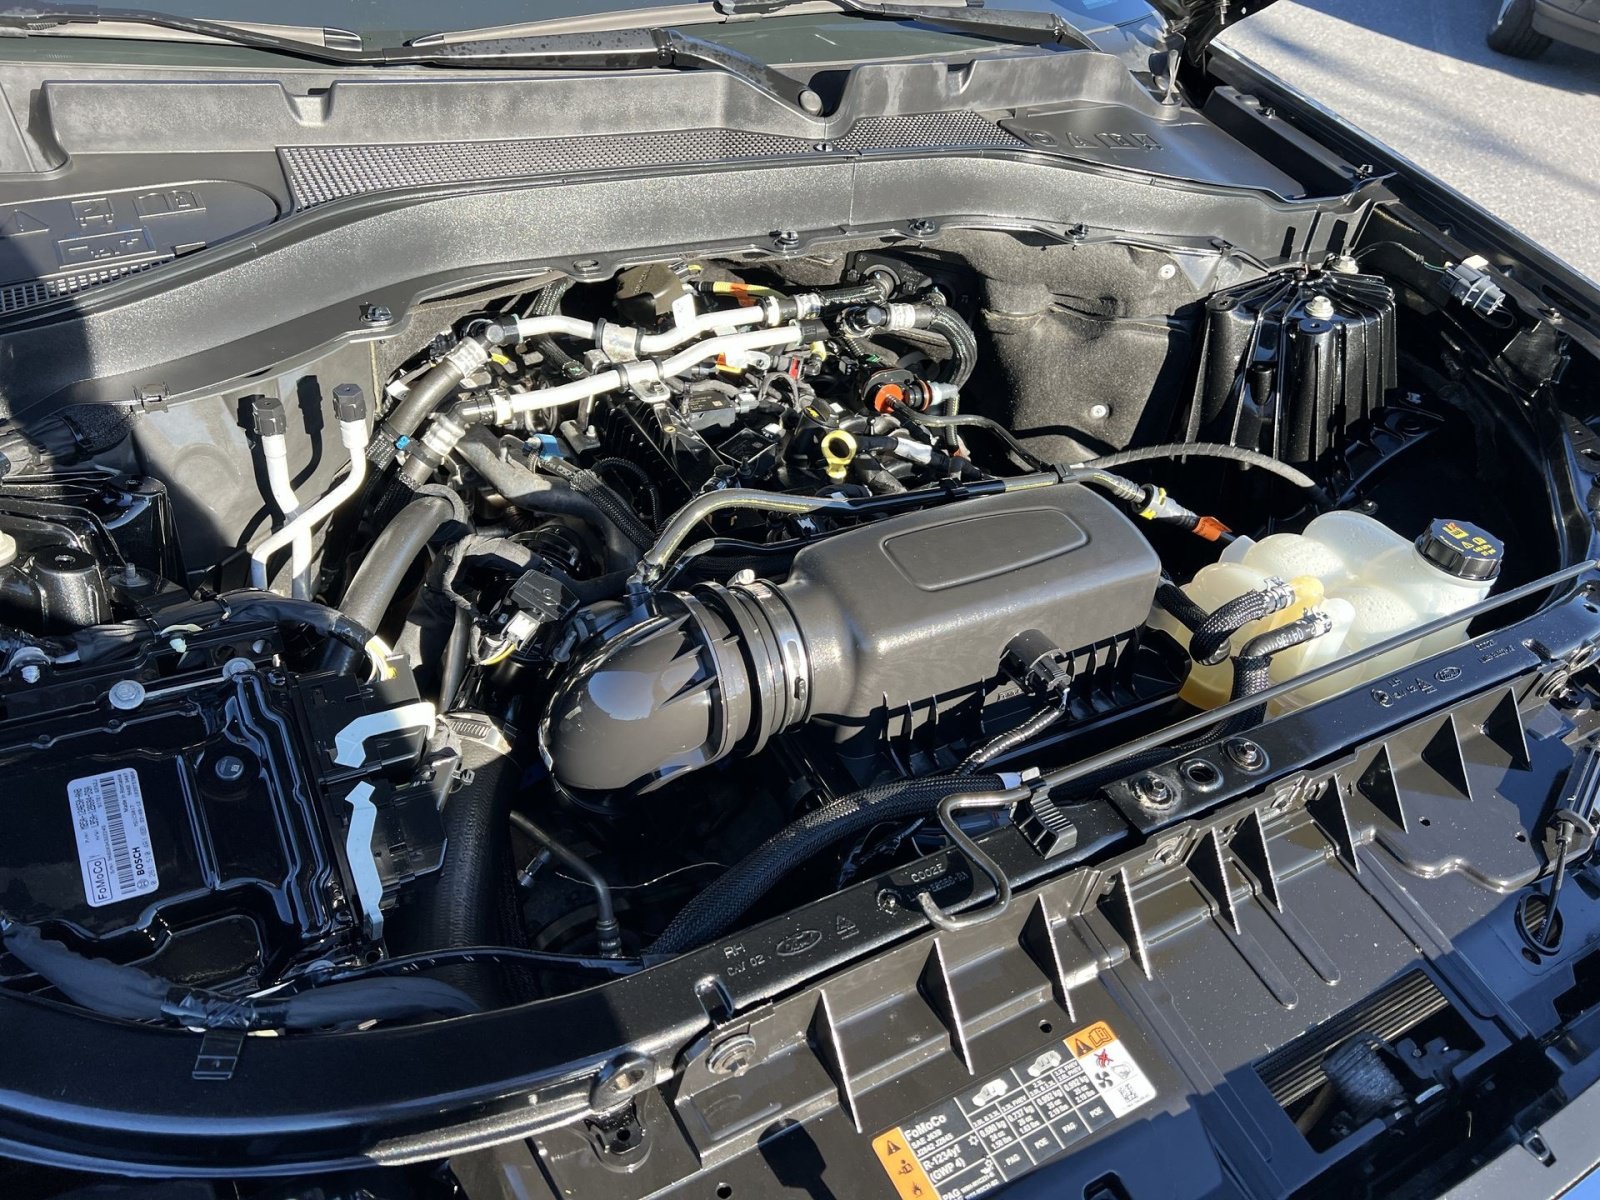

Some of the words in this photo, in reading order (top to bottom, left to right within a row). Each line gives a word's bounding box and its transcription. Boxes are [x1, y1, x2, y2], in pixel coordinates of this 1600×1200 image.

[132, 846, 145, 876] BOSCH
[93, 861, 107, 900] FoMoCo
[723, 943, 746, 960] RH
[750, 954, 765, 968] 02
[1078, 1075, 1090, 1084] kg
[1051, 1088, 1063, 1098] kg
[1023, 1104, 1035, 1114] kg
[1089, 1106, 1104, 1118] POE
[904, 1114, 947, 1141] FoMoCo
[995, 1120, 1007, 1129] kg
[911, 1137, 926, 1149] SAE
[1034, 1137, 1050, 1150] POE
[922, 1144, 961, 1171] R-1234yf
[1005, 1153, 1020, 1166] PAG
[930, 1162, 954, 1183] (GWP
[942, 1188, 961, 1200] PAG
